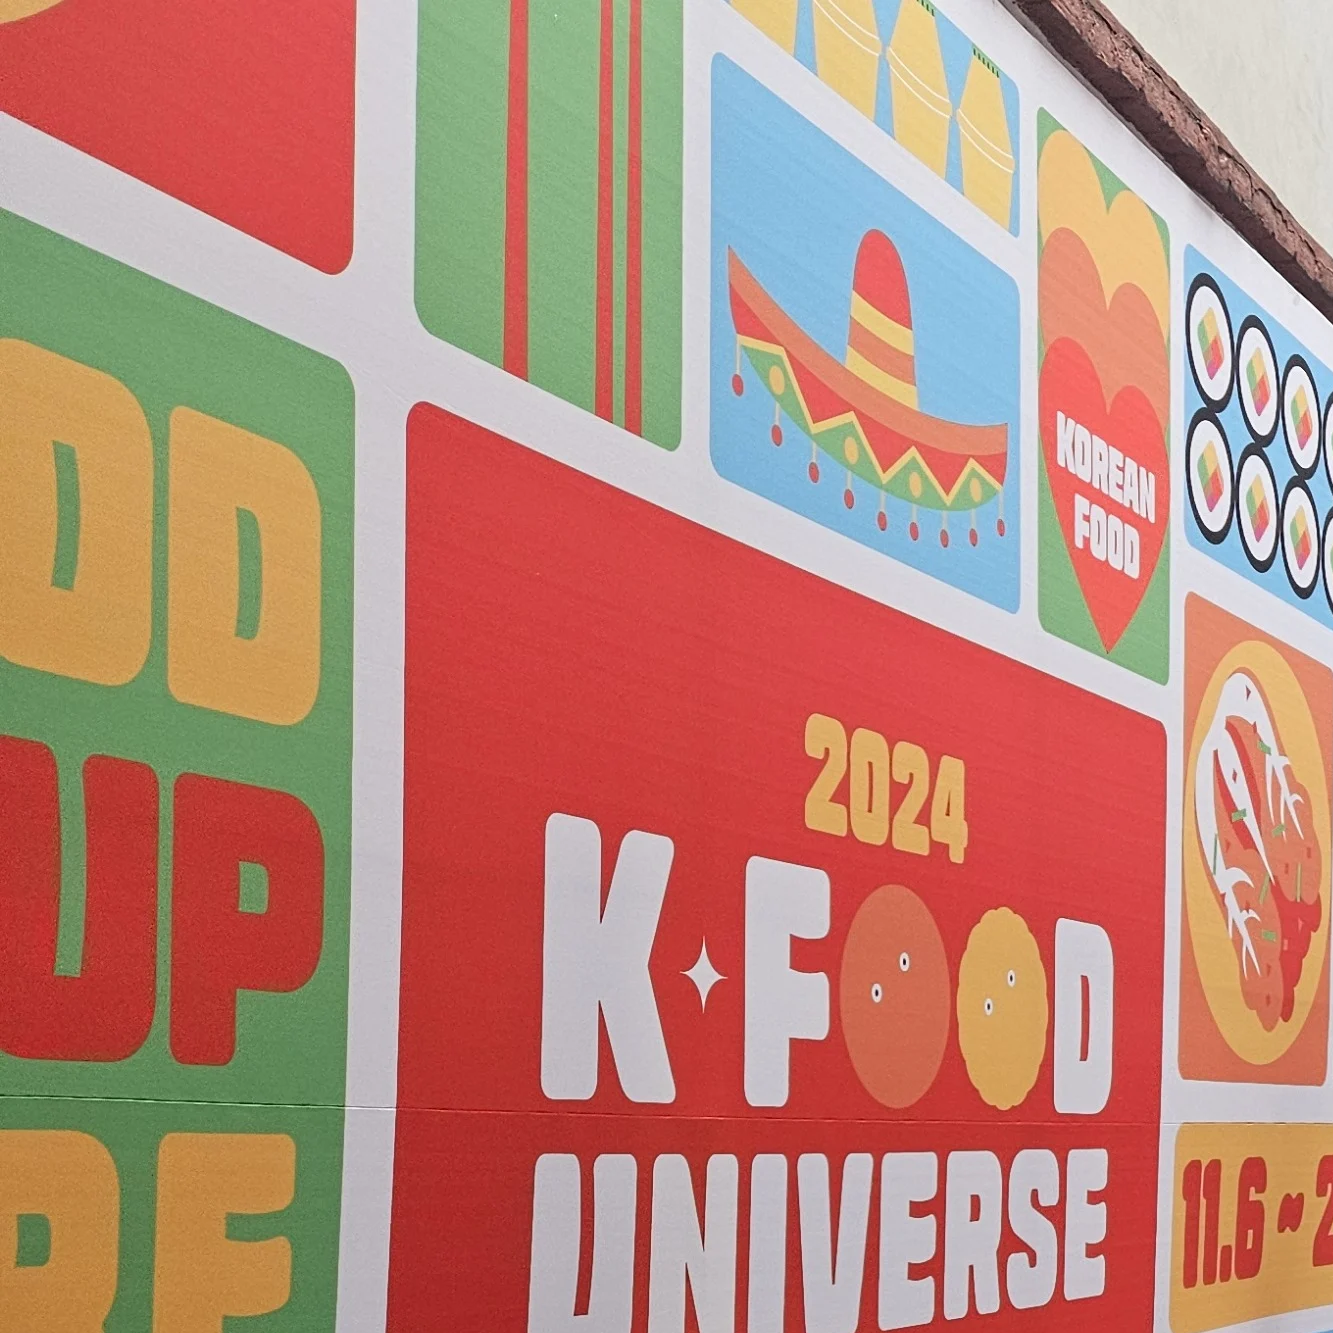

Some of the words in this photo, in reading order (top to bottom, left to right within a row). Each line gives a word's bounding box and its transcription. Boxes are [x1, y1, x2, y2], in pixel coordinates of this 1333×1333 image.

[1056, 409, 1156, 524] KOREAN
[1074, 493, 1140, 580] FOOD
[804, 713, 969, 865] 2024
[1182, 1156, 1267, 1289] 11.6
